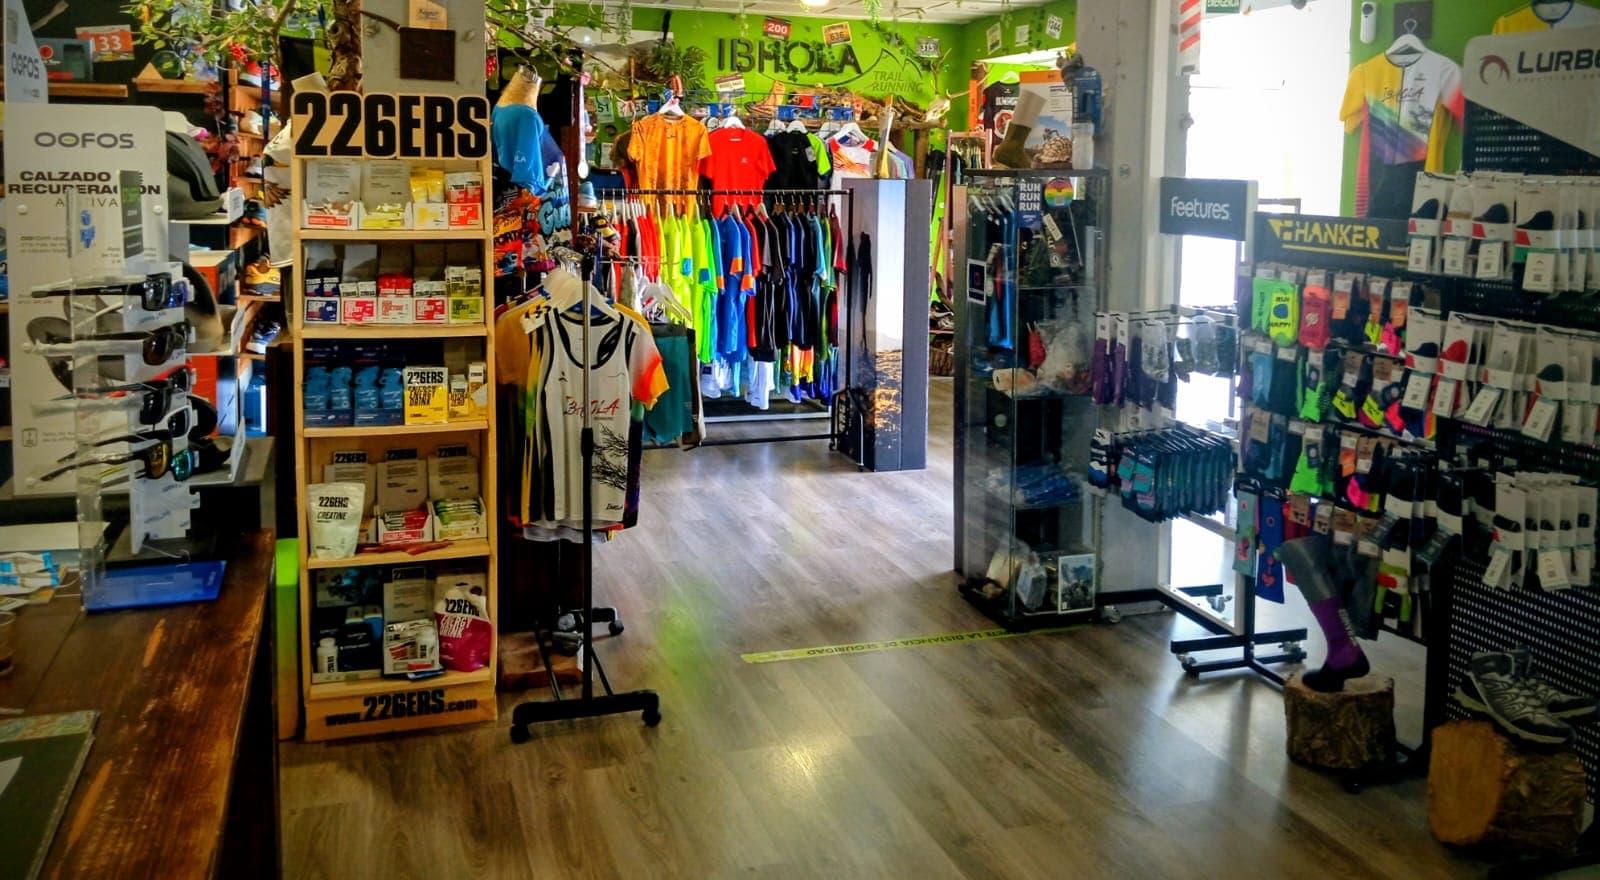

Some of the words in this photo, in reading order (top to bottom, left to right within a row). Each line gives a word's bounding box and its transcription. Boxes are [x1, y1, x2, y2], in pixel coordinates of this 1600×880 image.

[767, 23, 789, 35] 200
[920, 43, 936, 53] 315
[718, 38, 863, 74] IBHOLA
[873, 71, 904, 82] TRAIL
[871, 81, 924, 93] RUNNING
[294, 92, 488, 158] 226ERS
[34, 131, 135, 149] OOFOS
[20, 171, 112, 182] CALZADO
[8, 184, 161, 195] RECUPERAN
[1019, 183, 1041, 191] RUN
[1019, 193, 1041, 201] RUN
[55, 198, 119, 208] AIVA
[1018, 203, 1040, 211] RUN
[1171, 196, 1230, 220] feetures
[407, 371, 444, 384] 226ERS
[318, 496, 349, 508] 226ERS
[317, 511, 348, 520] CREATINE
